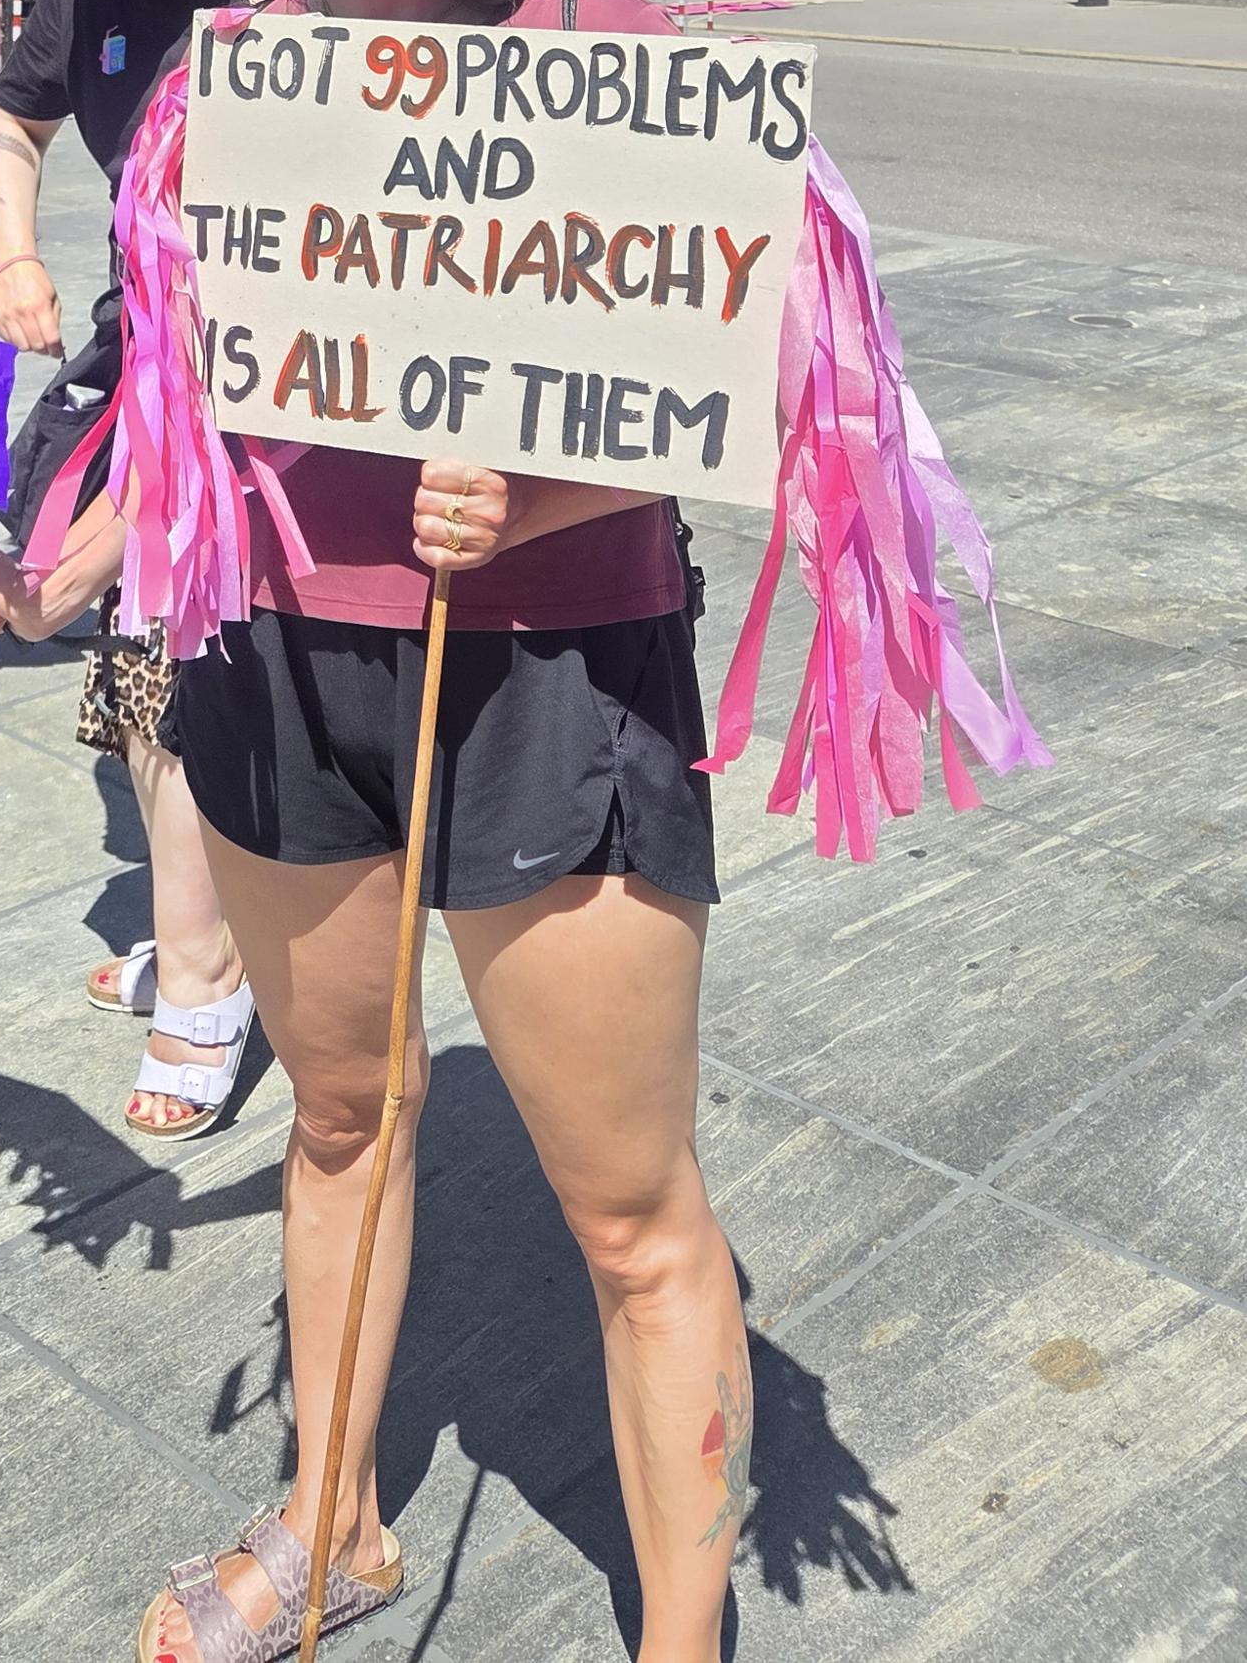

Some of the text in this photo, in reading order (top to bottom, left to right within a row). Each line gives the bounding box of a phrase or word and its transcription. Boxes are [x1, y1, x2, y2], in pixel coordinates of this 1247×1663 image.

[199, 26, 808, 161] I GOT 99 PROBLEMS
[382, 130, 534, 204] AND
[184, 204, 771, 324] THE PATRIARCHY
[205, 318, 730, 471] IS ALL OF THEM
